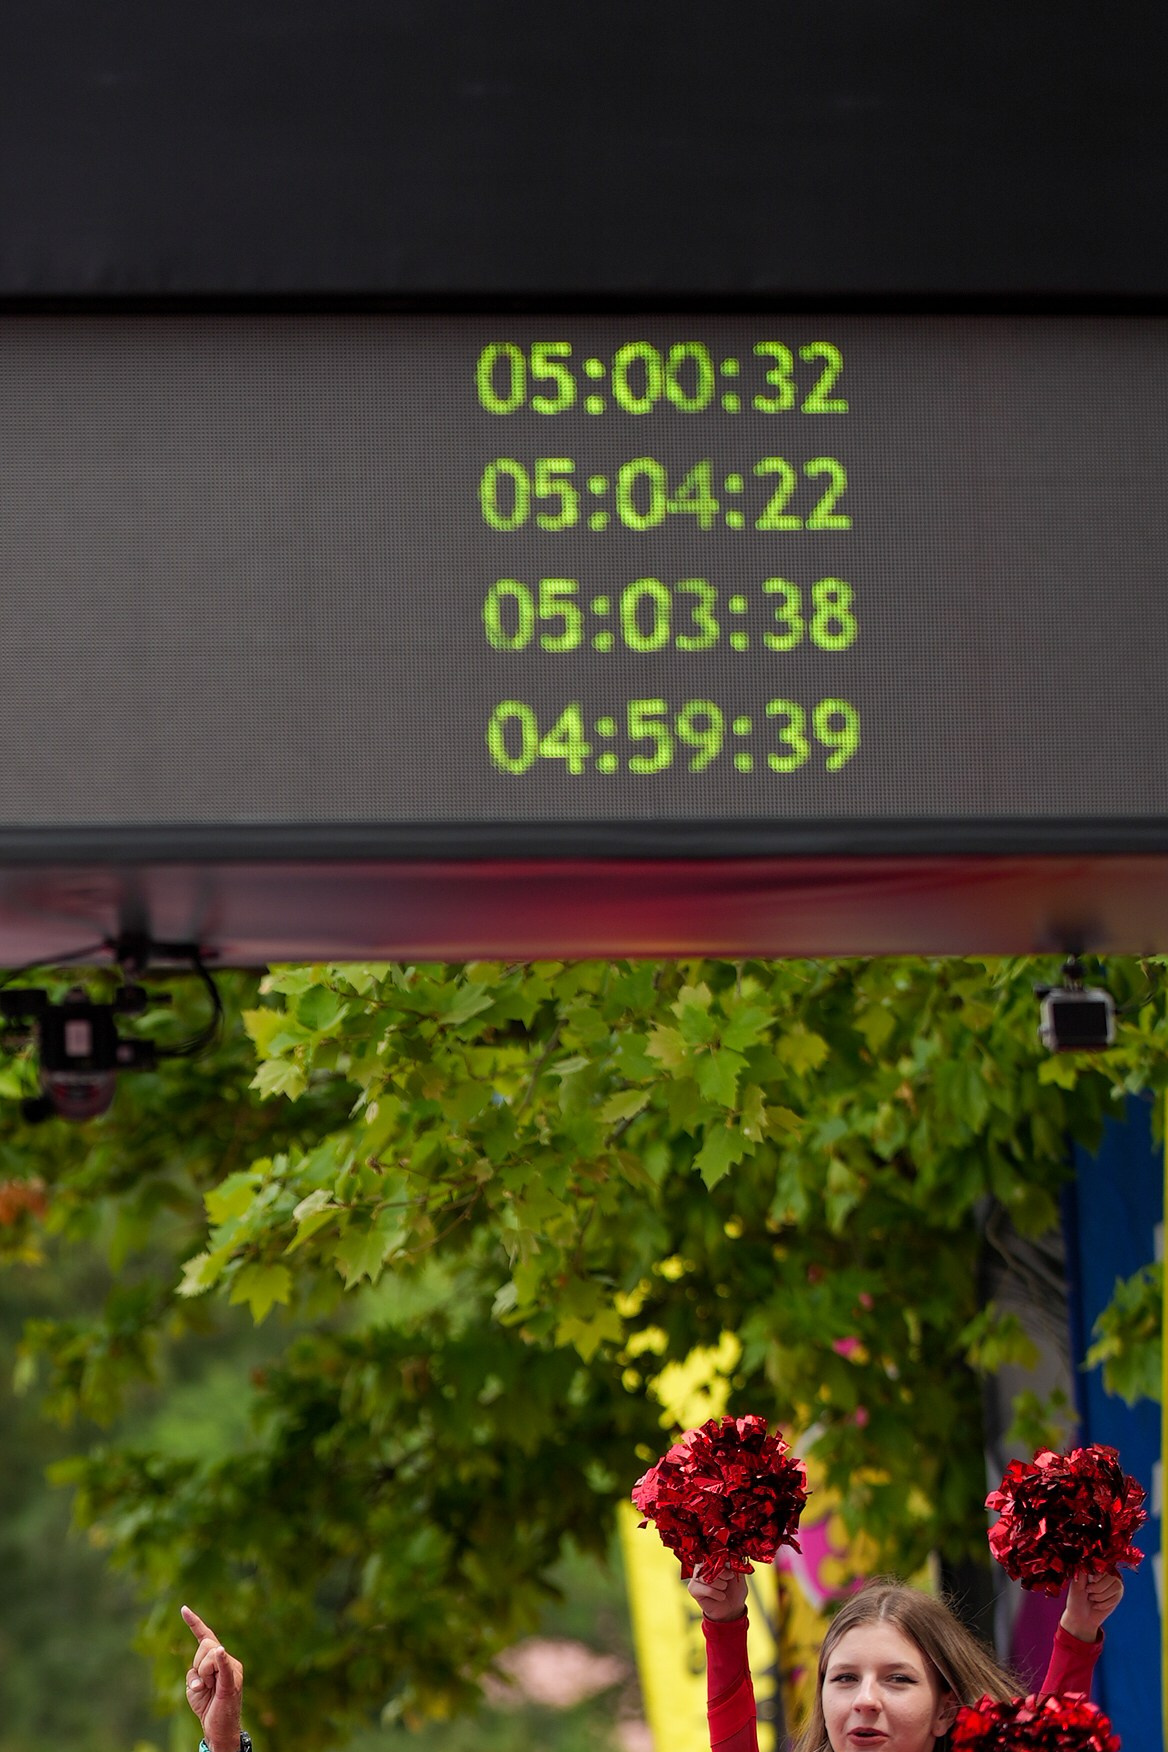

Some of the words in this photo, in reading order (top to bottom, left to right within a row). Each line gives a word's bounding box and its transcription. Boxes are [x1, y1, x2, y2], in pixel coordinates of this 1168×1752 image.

[476, 341, 850, 416] 05:00:32
[479, 457, 853, 531] 05:04:22
[483, 577, 858, 653] 05:03:38
[487, 698, 862, 775] 04:59:39
